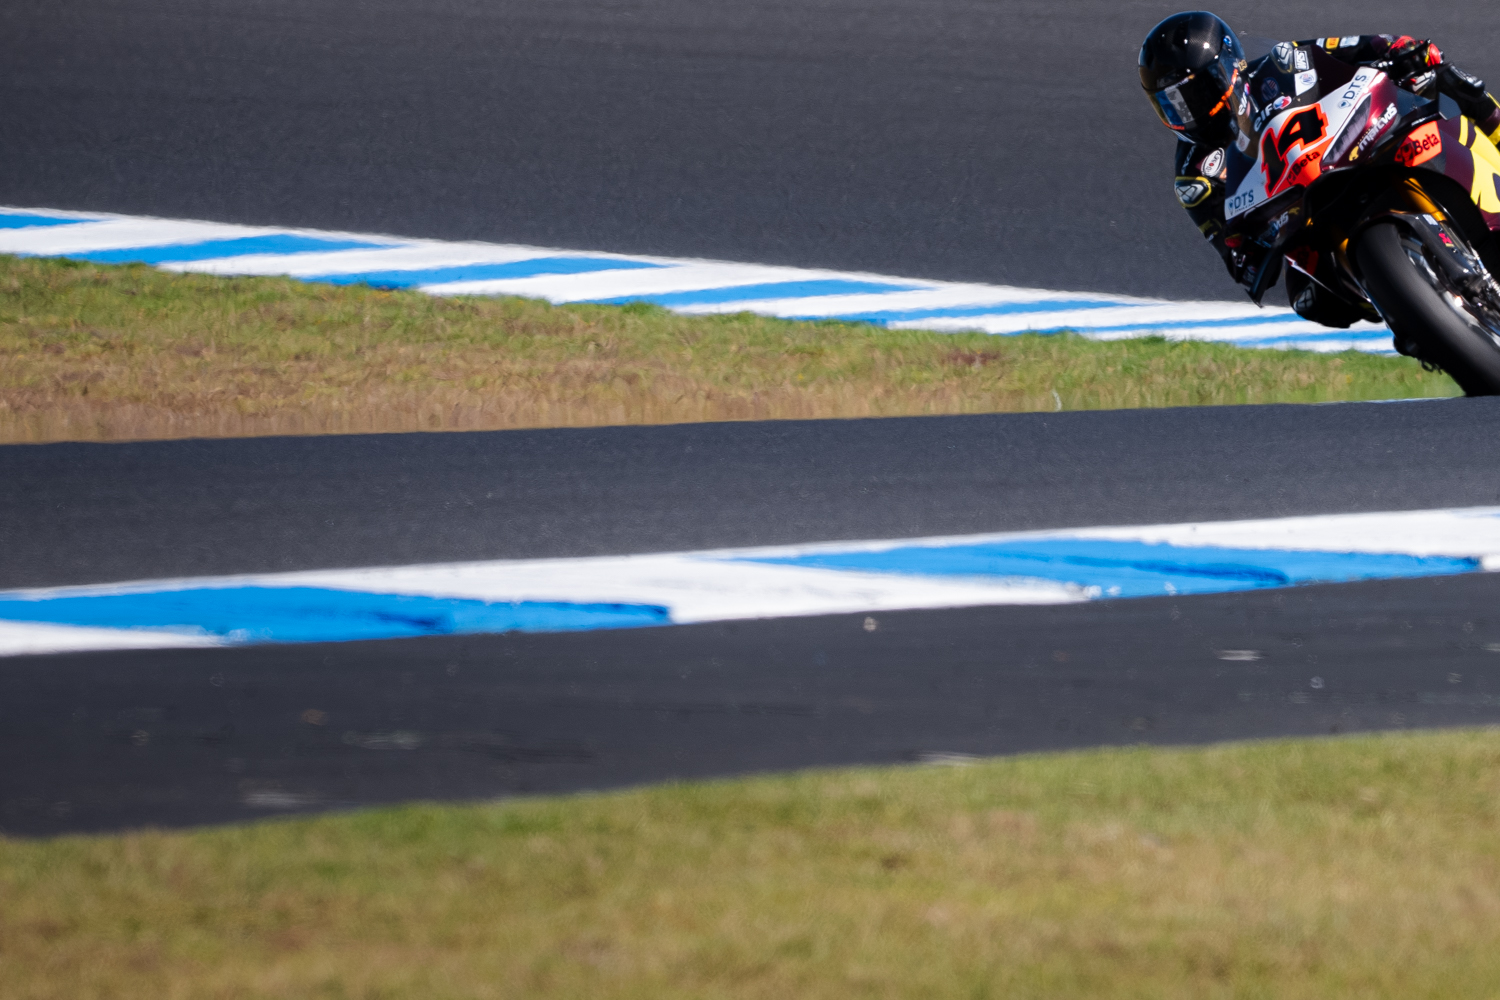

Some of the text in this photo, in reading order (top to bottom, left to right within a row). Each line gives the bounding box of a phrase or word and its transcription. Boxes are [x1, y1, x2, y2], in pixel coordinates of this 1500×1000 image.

[1343, 75, 1367, 99] DTS
[1261, 103, 1328, 197] 14
[1413, 133, 1440, 155] Beta
[1294, 151, 1320, 175] Beta
[1234, 190, 1254, 209] DTS
